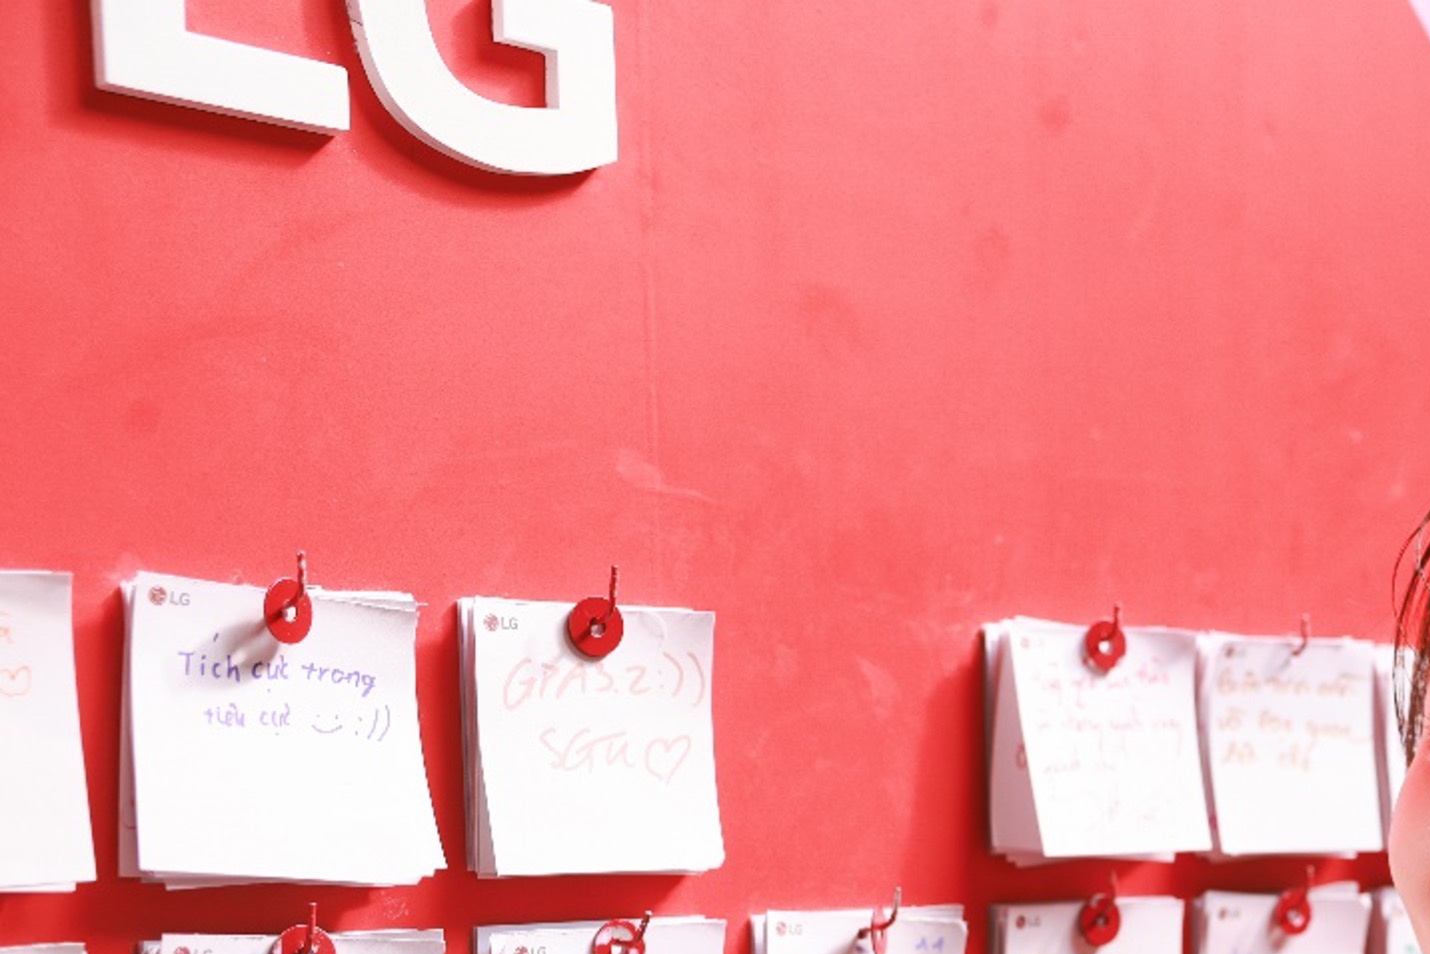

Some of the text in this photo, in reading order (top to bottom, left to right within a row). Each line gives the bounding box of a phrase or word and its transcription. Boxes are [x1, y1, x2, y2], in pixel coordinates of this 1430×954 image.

[169, 593, 190, 606] LG
[501, 617, 518, 630] LG
[301, 662, 376, 698] trong
[789, 924, 803, 936] LG
